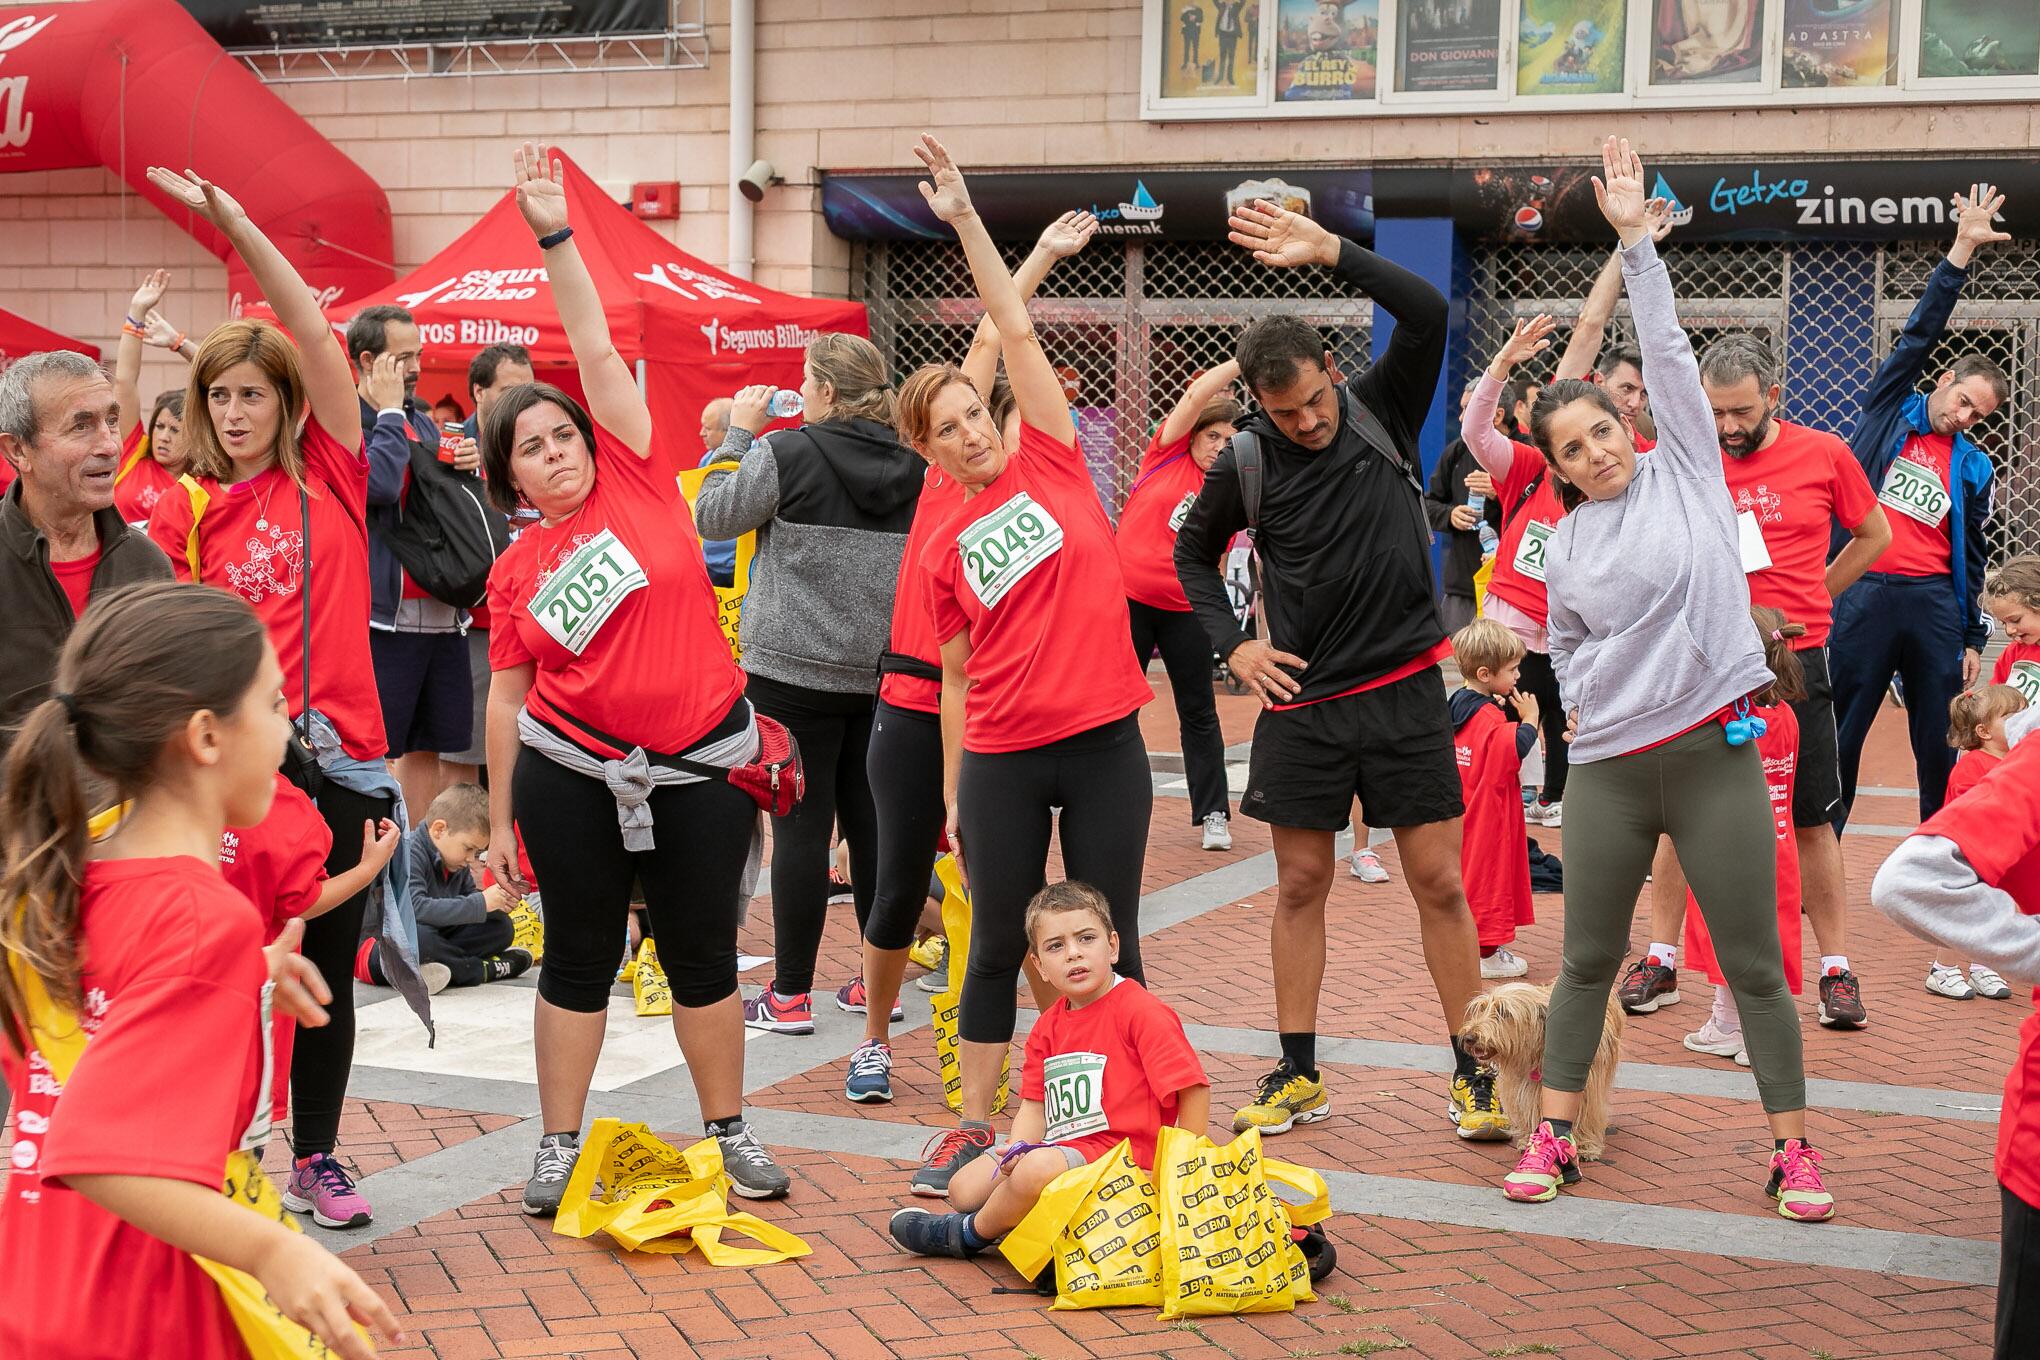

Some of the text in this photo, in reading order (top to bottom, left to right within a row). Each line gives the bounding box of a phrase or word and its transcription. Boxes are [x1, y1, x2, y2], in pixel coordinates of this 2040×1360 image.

[1788, 30, 1872, 41] AD ASTRA
[1410, 52, 1437, 62] DON
[1293, 65, 1357, 86] BURRO
[1710, 170, 1809, 215] Getxo
[1095, 221, 1163, 235] inemak
[455, 268, 549, 290] Segur
[461, 319, 540, 346] Bilbao
[720, 326, 774, 354] Seguros
[1888, 473, 1946, 513] 2036
[968, 513, 1045, 587] 2049
[549, 552, 625, 634] 2051
[1113, 1178, 1130, 1192] BM
[1198, 1186, 1216, 1201] BM
[1132, 1204, 1150, 1219] BM
[1088, 1211, 1106, 1228] BM
[1209, 1216, 1227, 1230] BM
[1105, 1238, 1122, 1254] BM
[1260, 1243, 1275, 1259] BM
[1066, 1250, 1083, 1265] BM
[1179, 1248, 1197, 1261] BM
[1222, 1250, 1240, 1262] BM
[1103, 1278, 1152, 1290] MATERIAL RECICLADO
